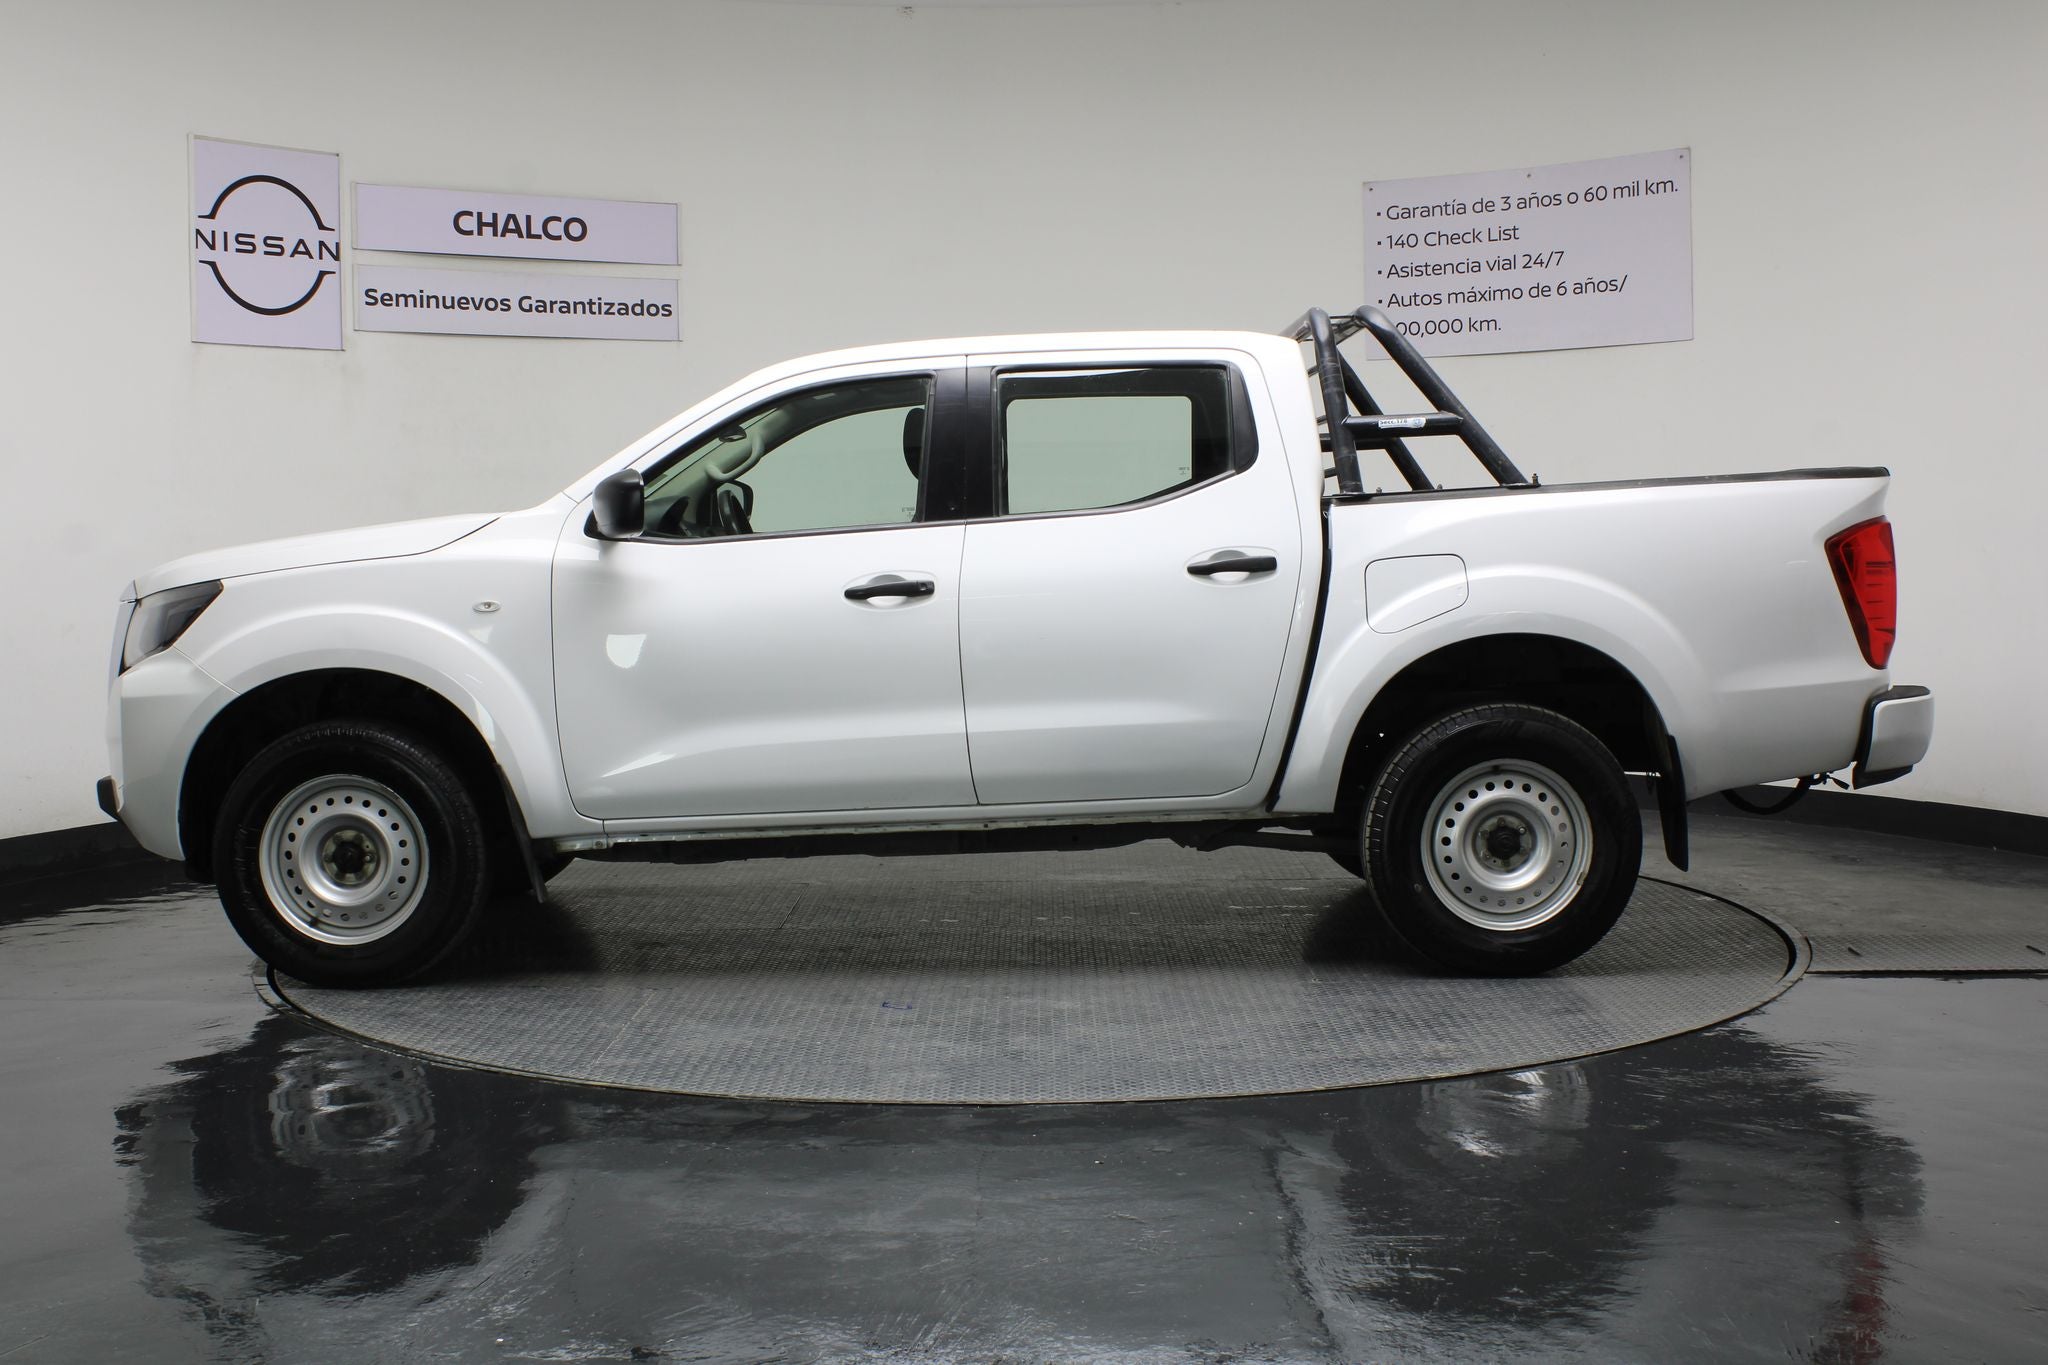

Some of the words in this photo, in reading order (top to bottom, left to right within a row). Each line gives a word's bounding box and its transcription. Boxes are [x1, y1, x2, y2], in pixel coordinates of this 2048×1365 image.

[1386, 201, 1467, 221] Garantía
[1471, 197, 1496, 214] de
[1500, 195, 1512, 212] 3
[1516, 191, 1563, 210] años
[1566, 191, 1579, 205] o
[1583, 185, 1608, 203] 60
[1613, 180, 1640, 200] mil
[1645, 178, 1679, 197] km.
[452, 210, 588, 243] CHALCO
[1386, 233, 1419, 250] 140
[1423, 227, 1483, 247] Check
[1487, 225, 1520, 243] List
[195, 228, 341, 262] NISSAN
[1386, 259, 1482, 279] Asistencia
[1485, 254, 1517, 272] vial
[1521, 250, 1565, 270] 24/7
[364, 288, 512, 313] Seminuevos
[517, 295, 673, 318] Garantizados
[1386, 292, 1443, 309] Autos
[1447, 286, 1524, 305] máximo
[1528, 282, 1552, 299] de
[1556, 280, 1568, 297] 6
[1572, 274, 1628, 296] años/
[1395, 318, 1464, 339] 00,000
[1468, 316, 1502, 333] km.
